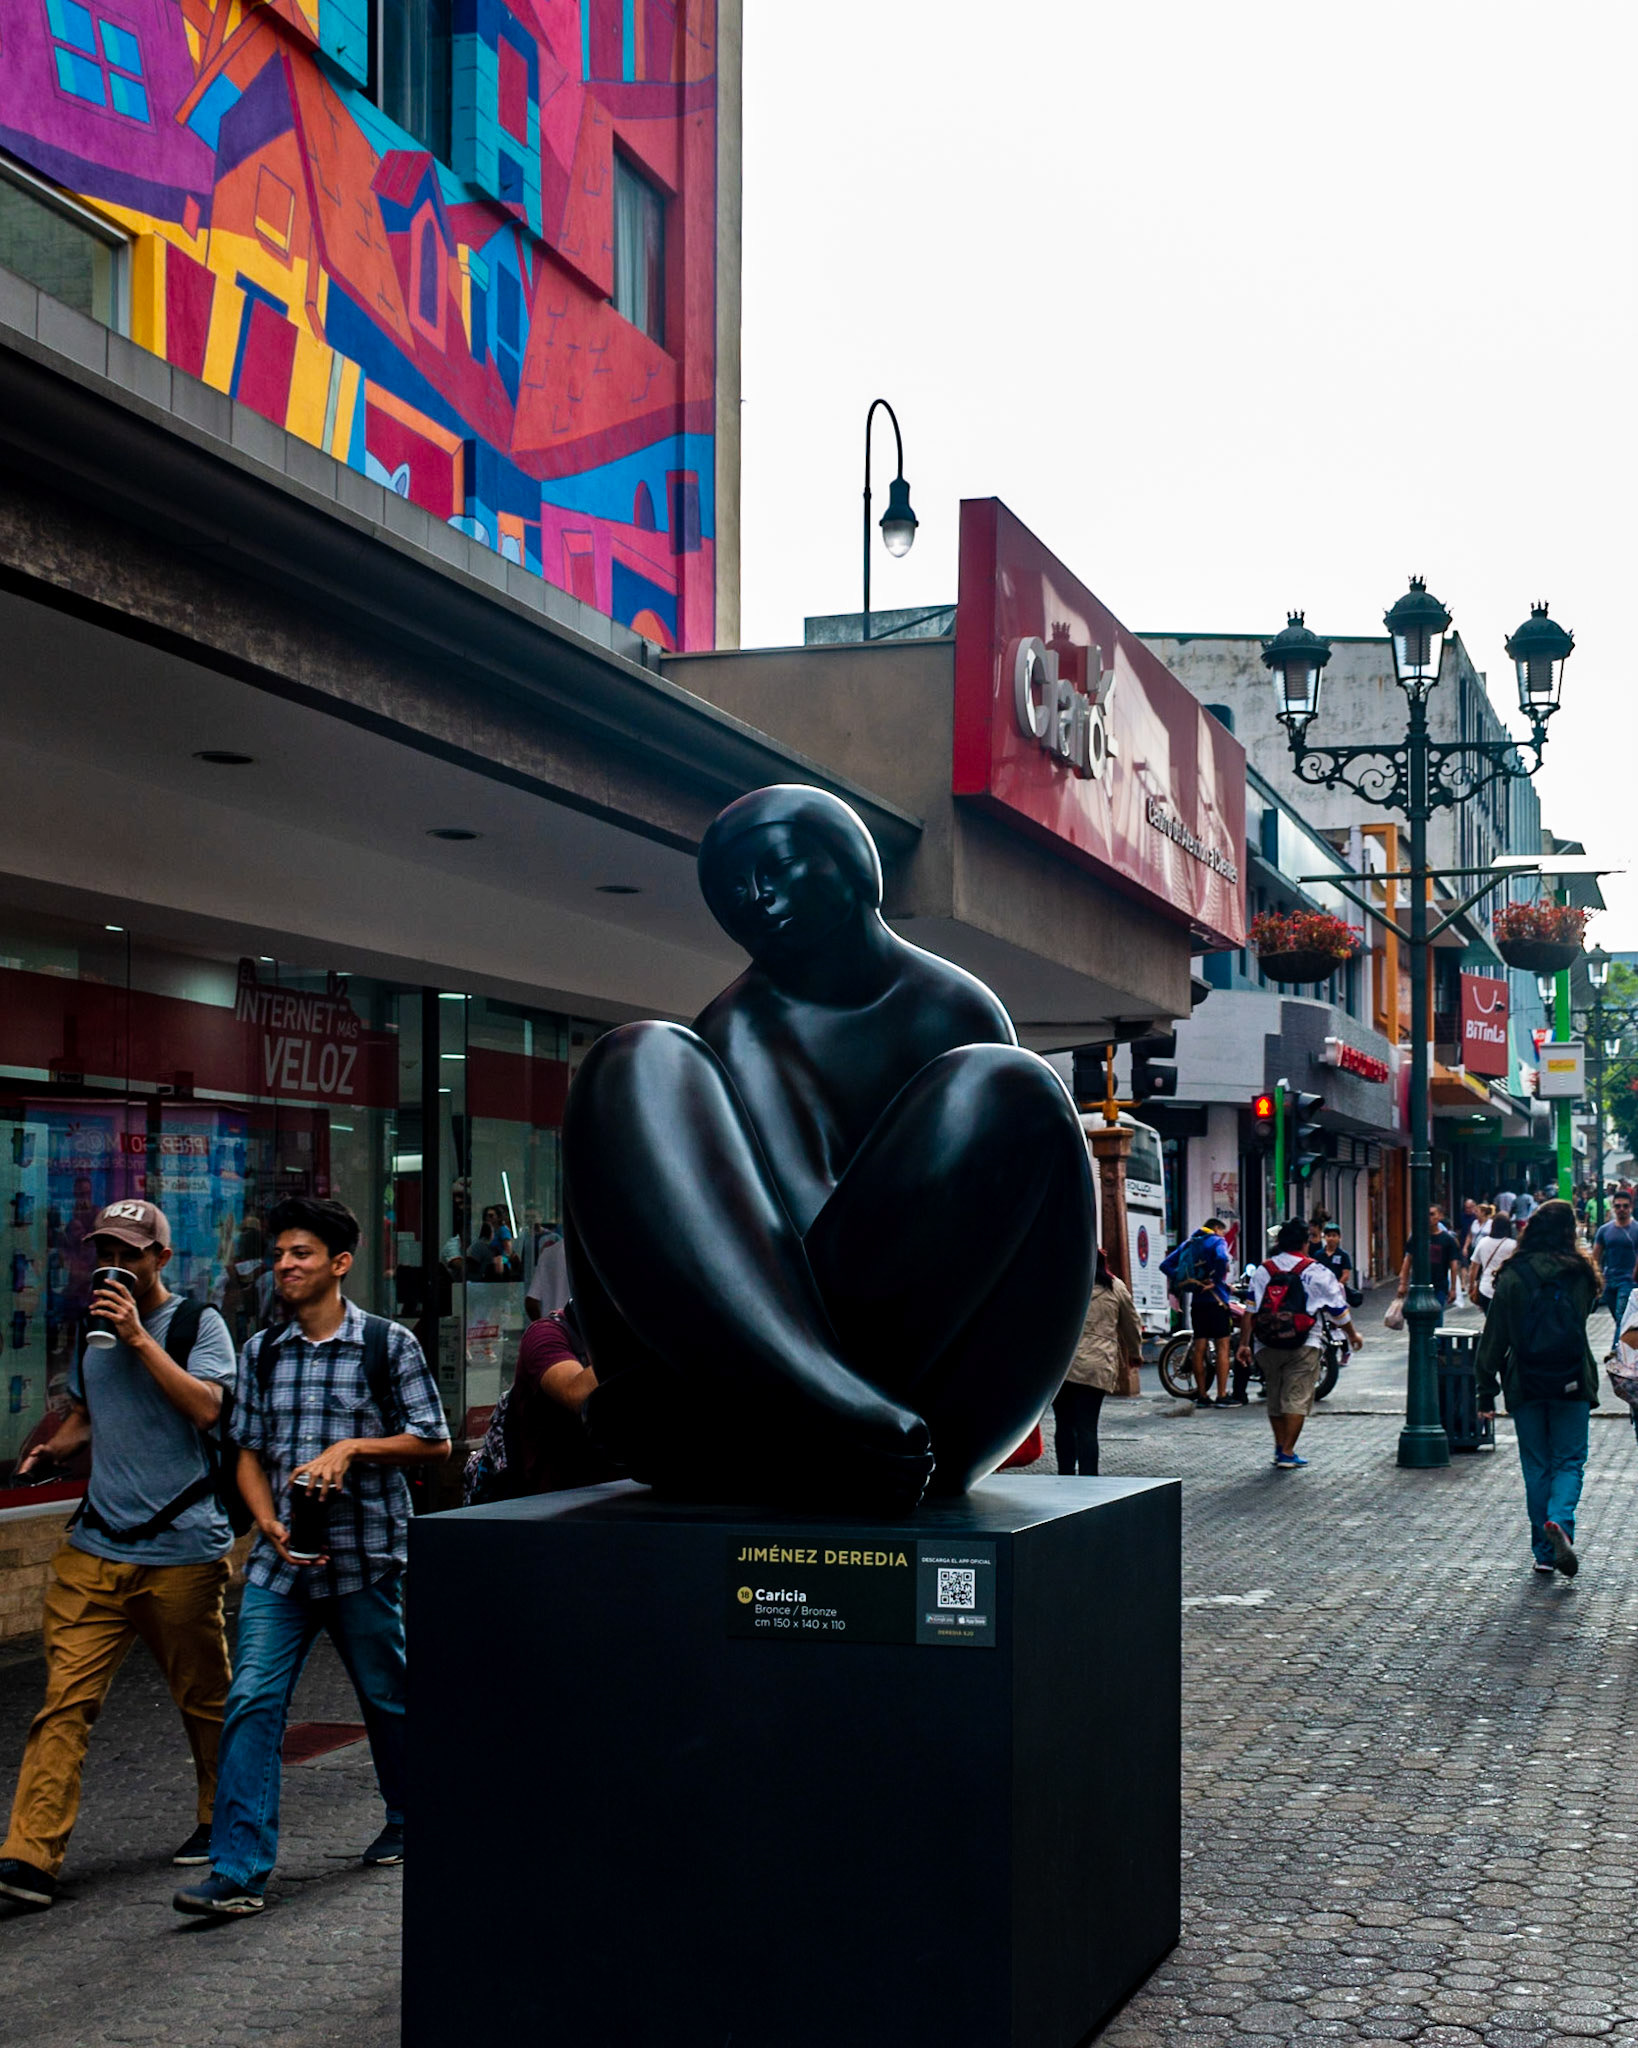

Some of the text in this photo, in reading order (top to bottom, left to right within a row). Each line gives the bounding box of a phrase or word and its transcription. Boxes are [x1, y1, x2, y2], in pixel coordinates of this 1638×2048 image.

[1015, 636, 1108, 780] Claro
[235, 986, 338, 1035] INTERNET
[264, 1033, 358, 1095] VELOZ
[737, 1544, 908, 1567] JIMÉNEZ DEREDIA
[921, 1556, 950, 1564] DESCARGA
[755, 1588, 807, 1603] Caricia
[755, 1604, 837, 1617] Bronce / Bronze
[754, 1619, 770, 1628] cm
[773, 1617, 790, 1629] 150
[801, 1618, 820, 1629] 140
[831, 1619, 846, 1631] 110
